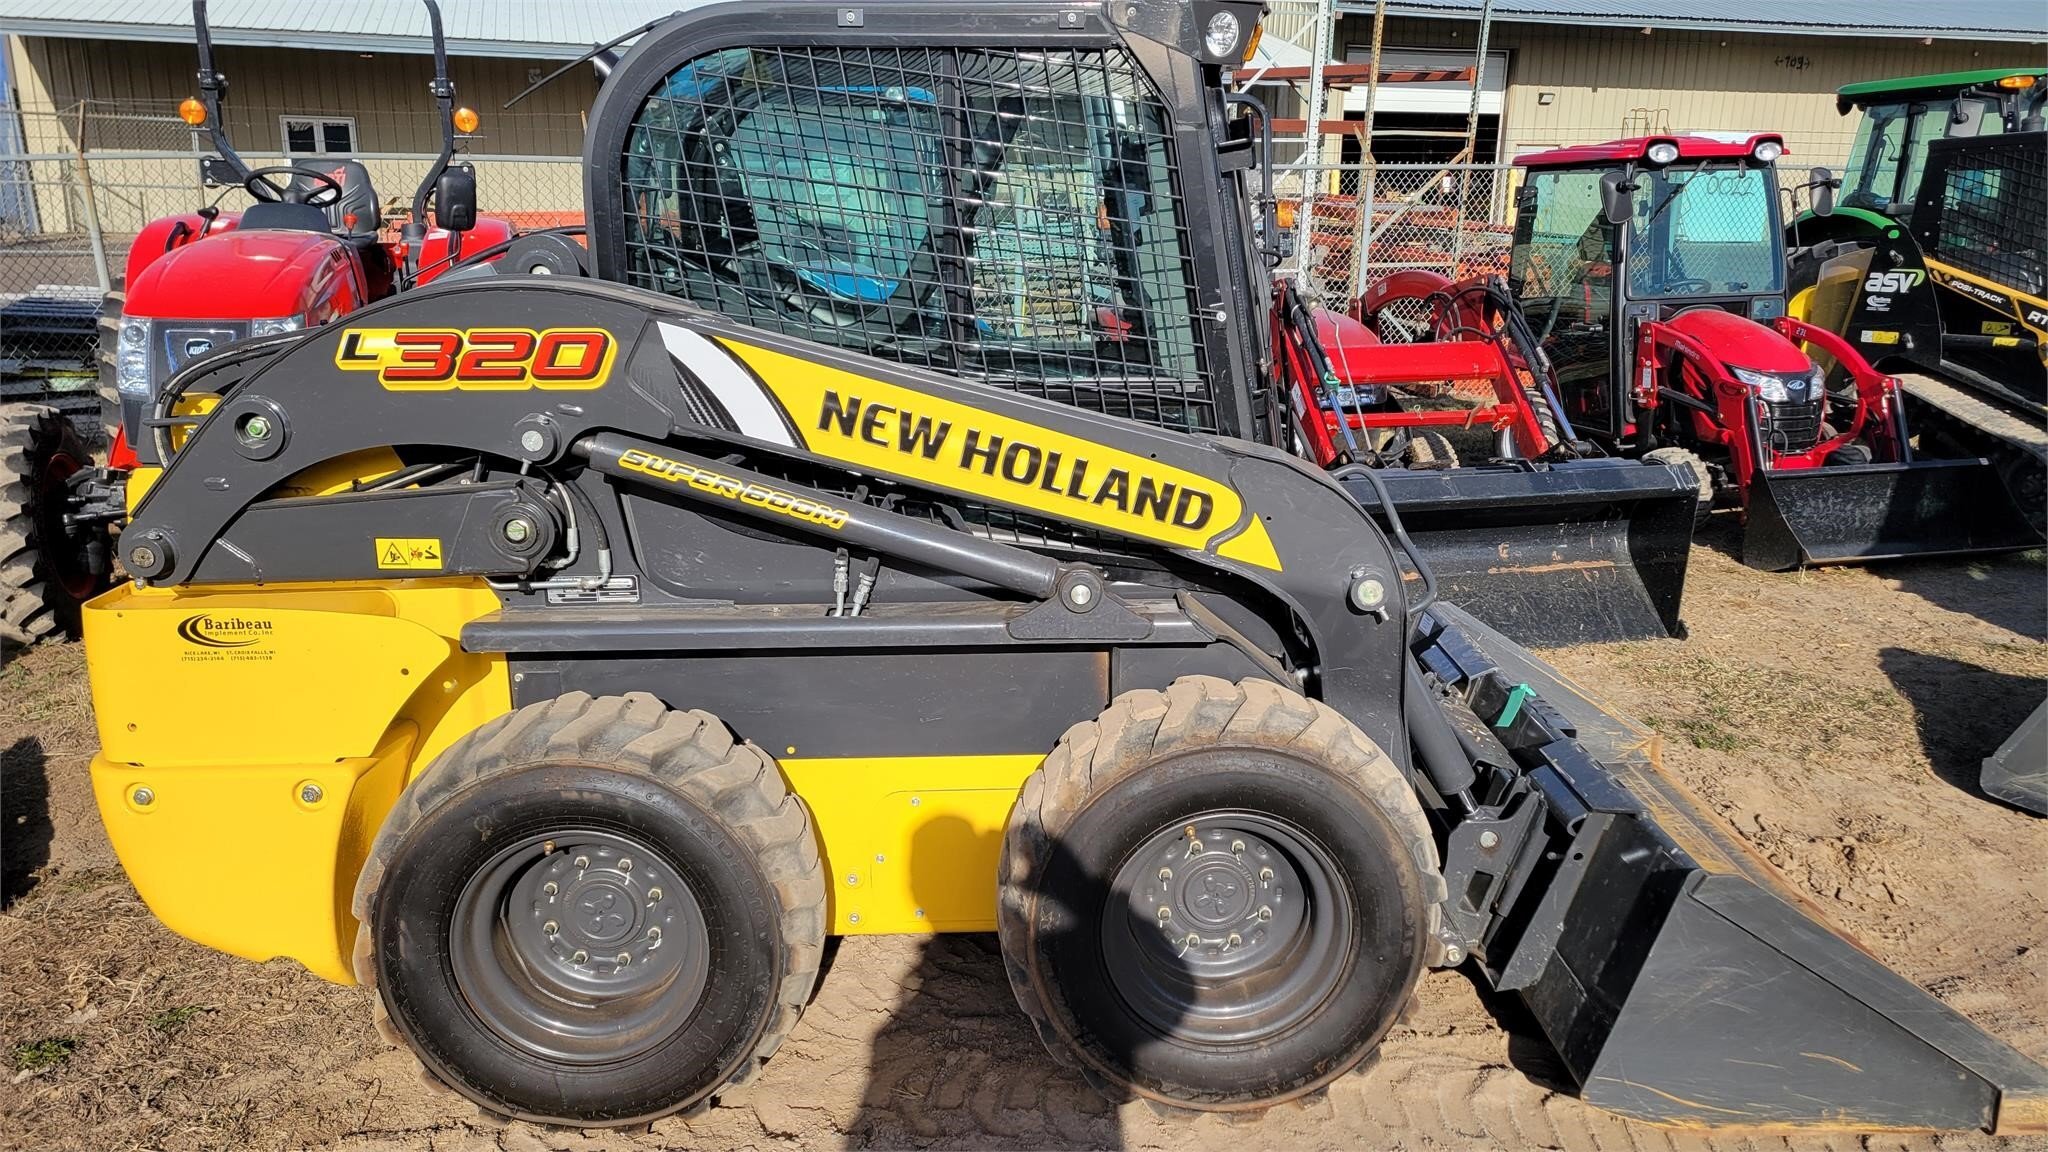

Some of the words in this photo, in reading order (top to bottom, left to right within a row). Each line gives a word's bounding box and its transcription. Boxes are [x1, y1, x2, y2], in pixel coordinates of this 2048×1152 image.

[1951, 280, 2005, 304] POSI-TRACK
[816, 388, 953, 462] NEW
[959, 429, 1214, 532] HOLLAND
[620, 450, 741, 498] SUPER
[743, 485, 848, 528] BOOM
[203, 618, 273, 630] Baribeau
